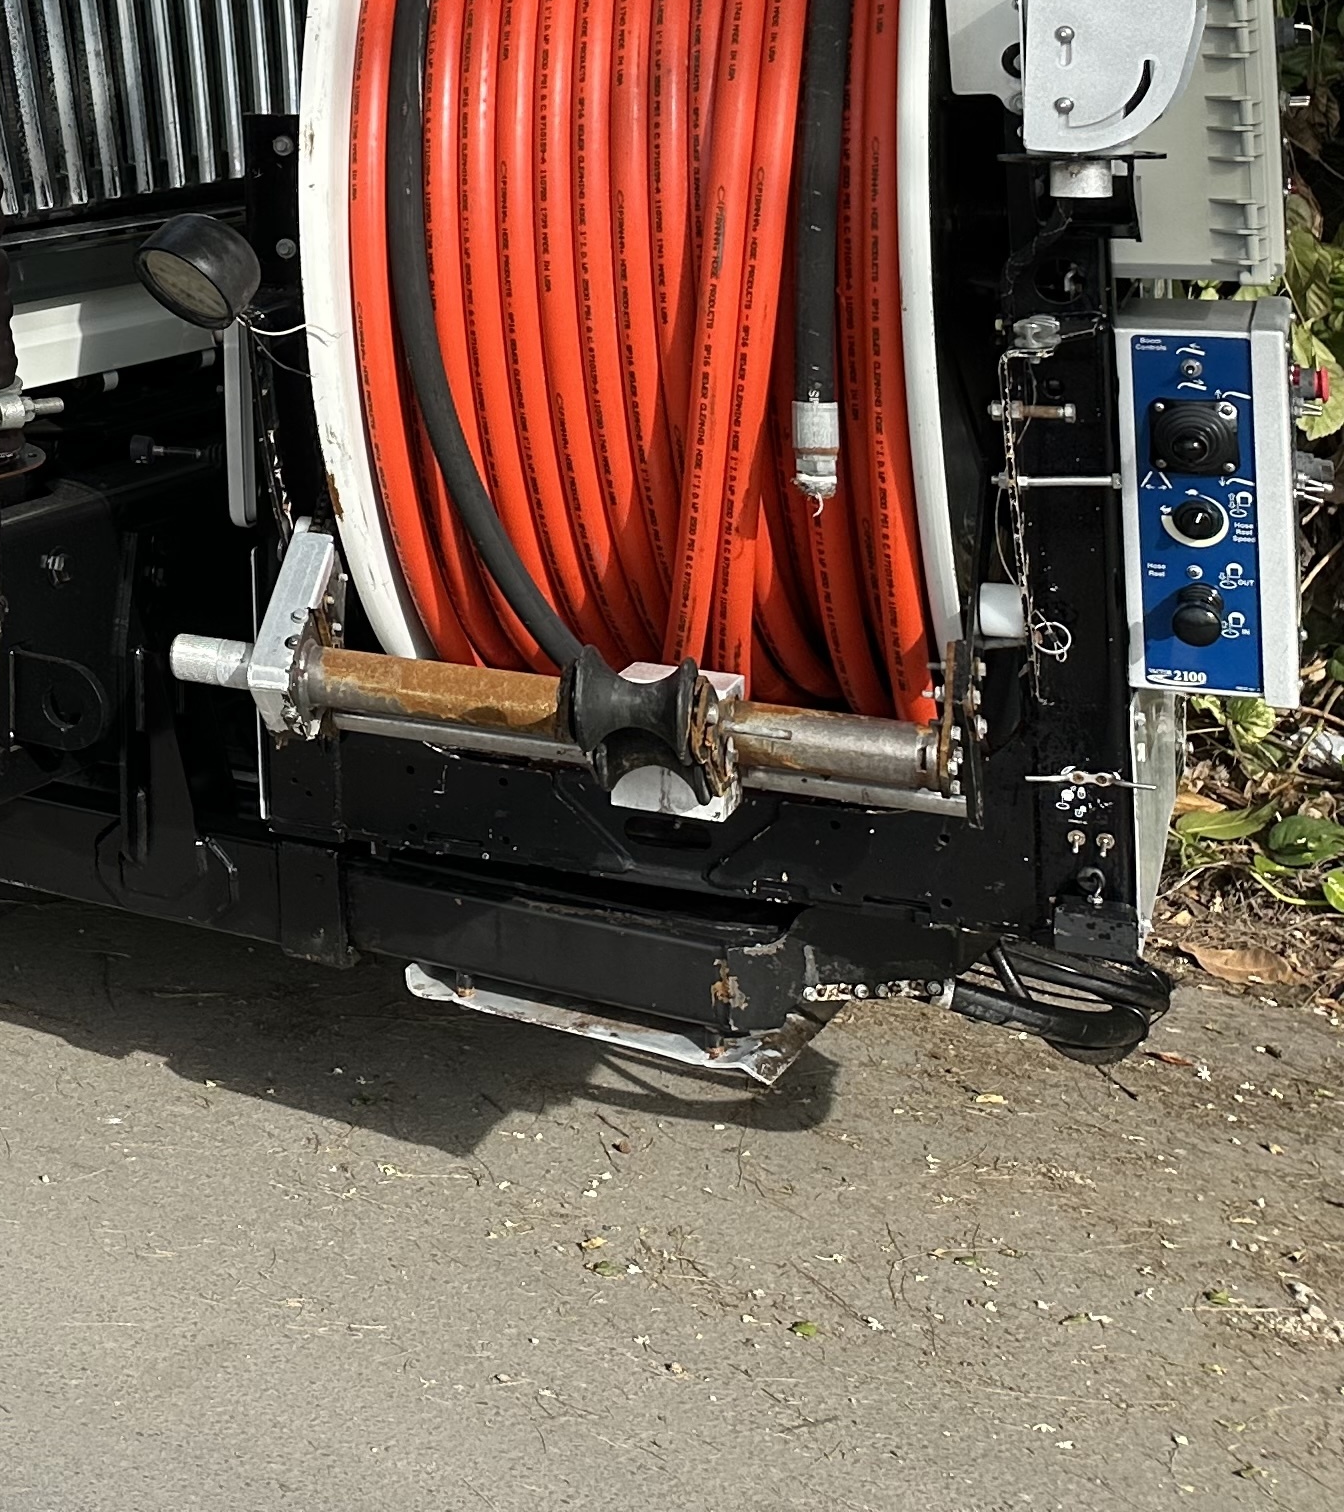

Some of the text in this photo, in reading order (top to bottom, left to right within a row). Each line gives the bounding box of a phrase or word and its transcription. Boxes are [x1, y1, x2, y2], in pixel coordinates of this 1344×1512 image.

[1147, 562, 1167, 570] Hose
[1237, 579, 1255, 587] OUT
[1173, 670, 1207, 683] 2100
